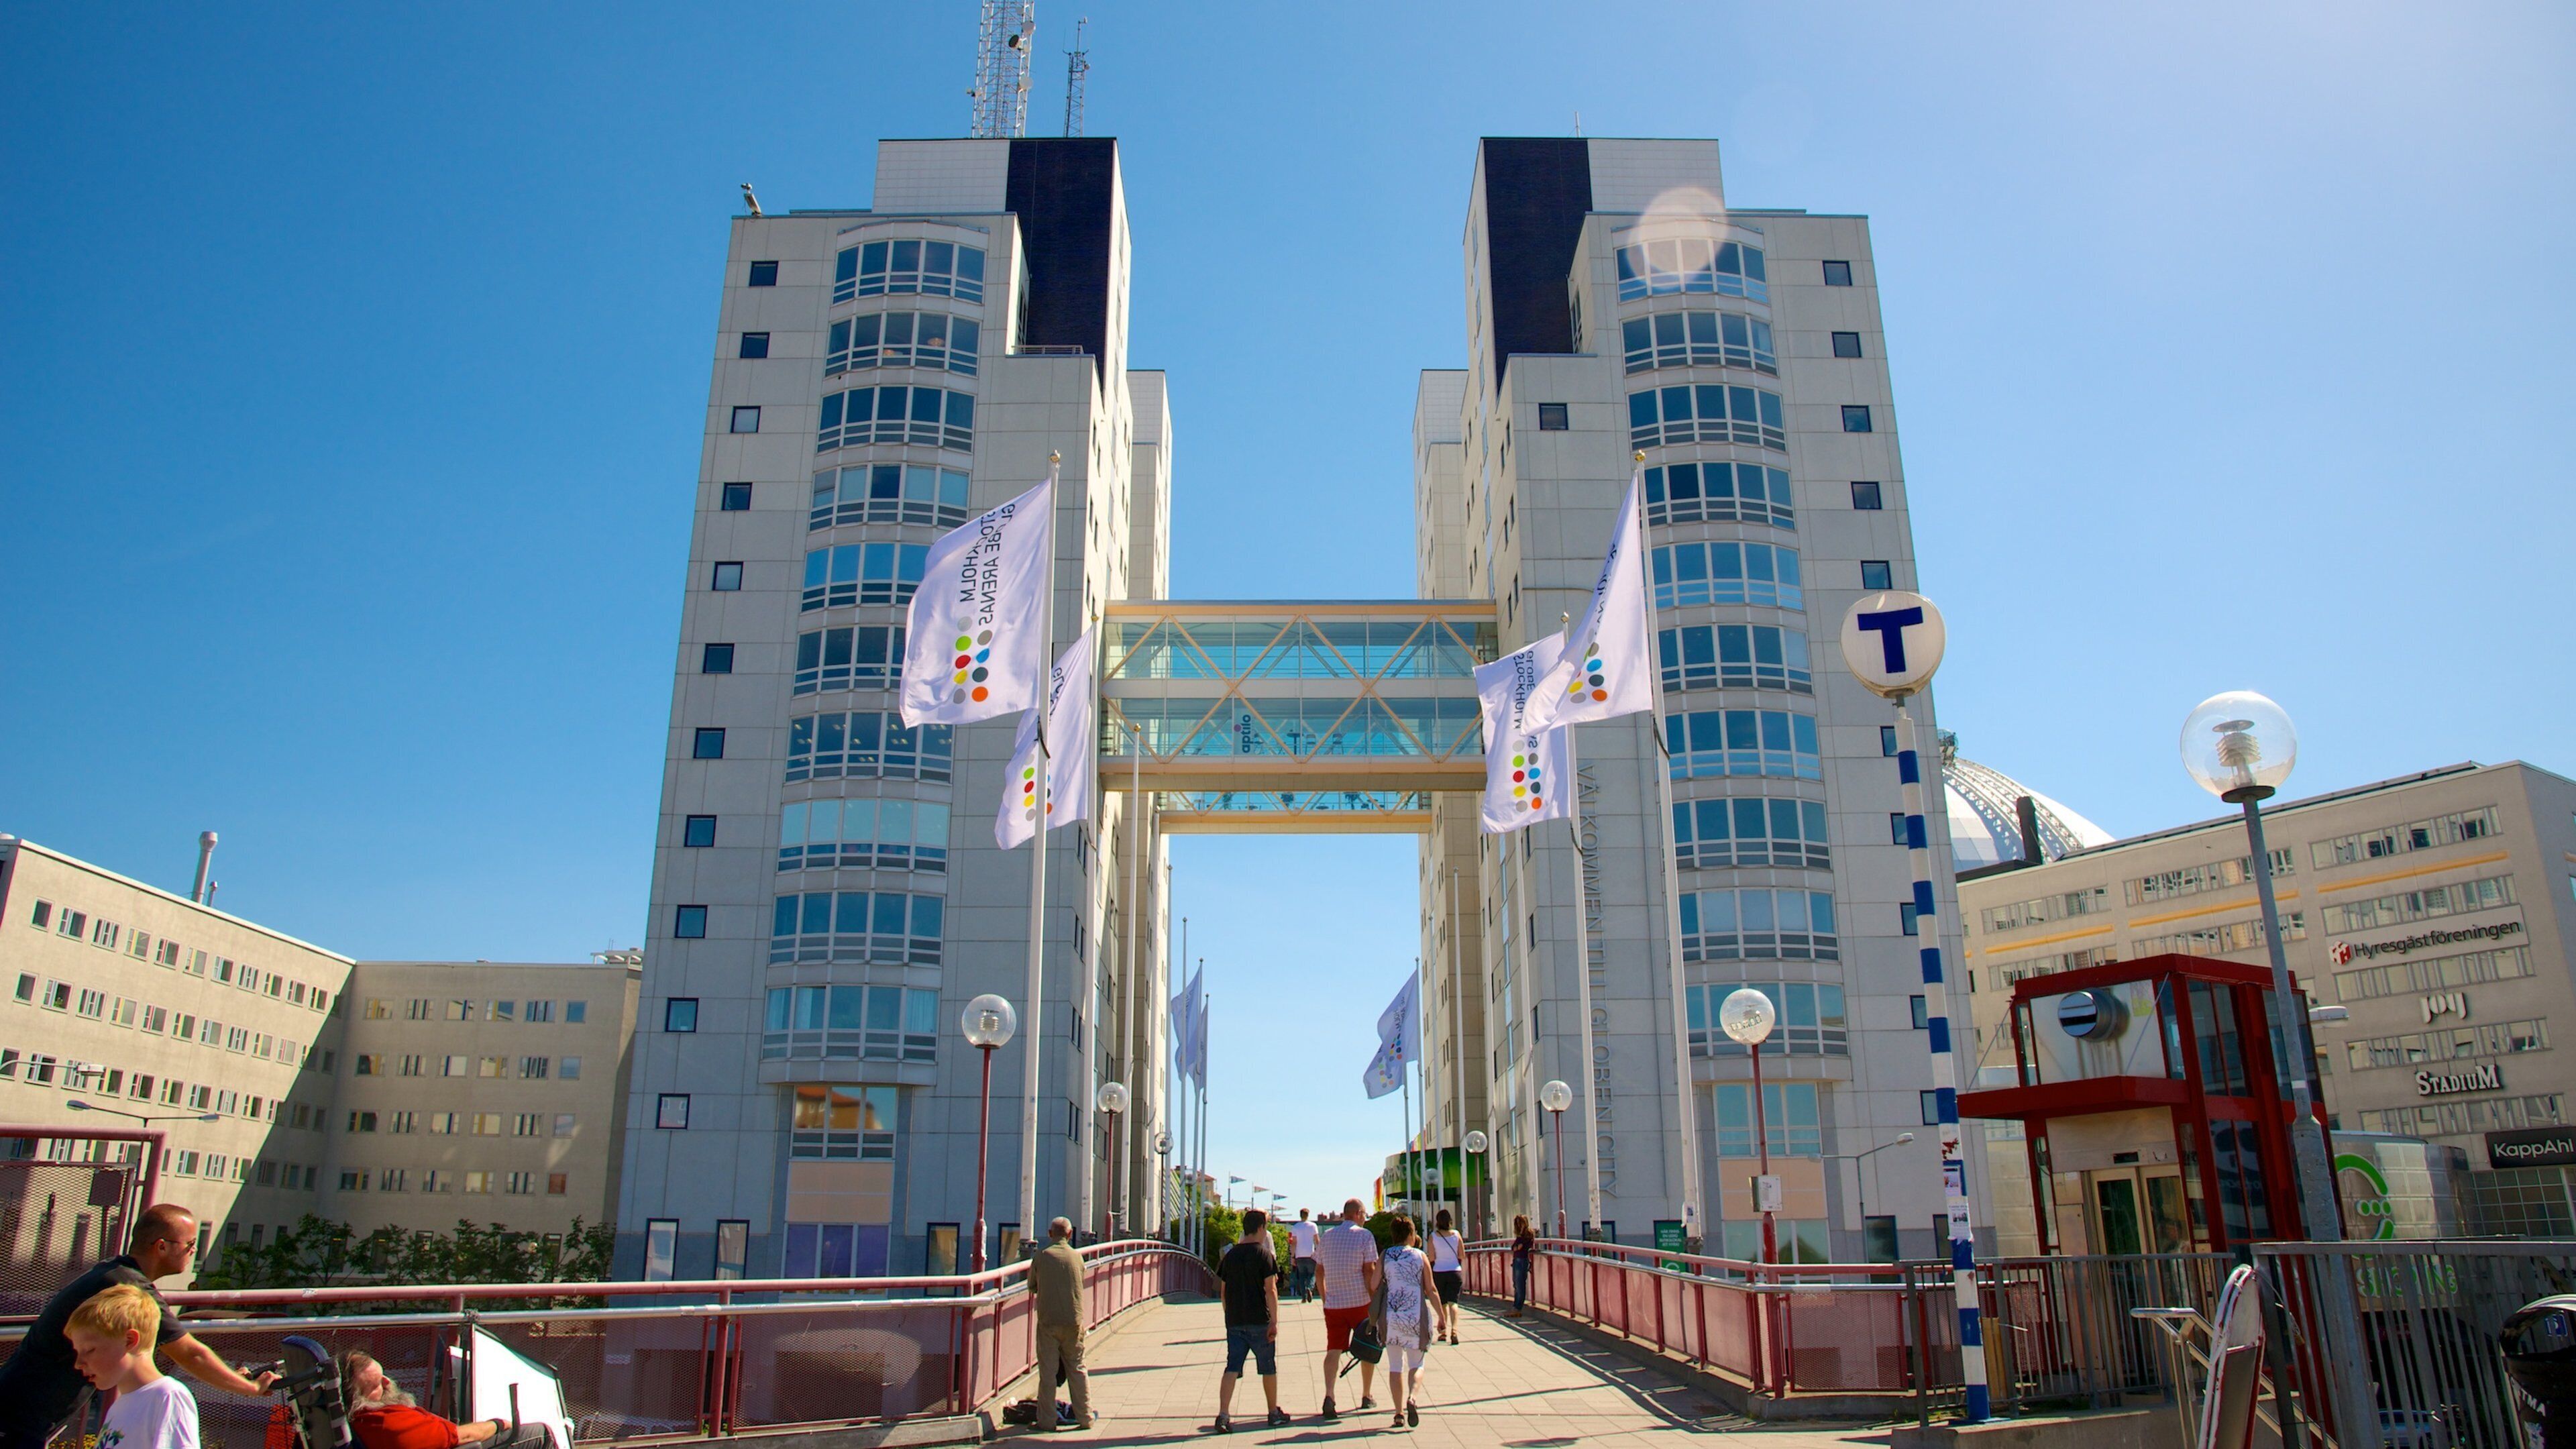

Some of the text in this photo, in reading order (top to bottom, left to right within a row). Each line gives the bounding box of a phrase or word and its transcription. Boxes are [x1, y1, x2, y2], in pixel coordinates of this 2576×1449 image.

[1857, 606, 1923, 674] T
[1240, 714, 1254, 753] aptilo
[2353, 920, 2521, 959] Hyresgästföreningen
[1597, 1132, 1618, 1198] CITY
[2494, 1138, 2575, 1159] KappAhl
